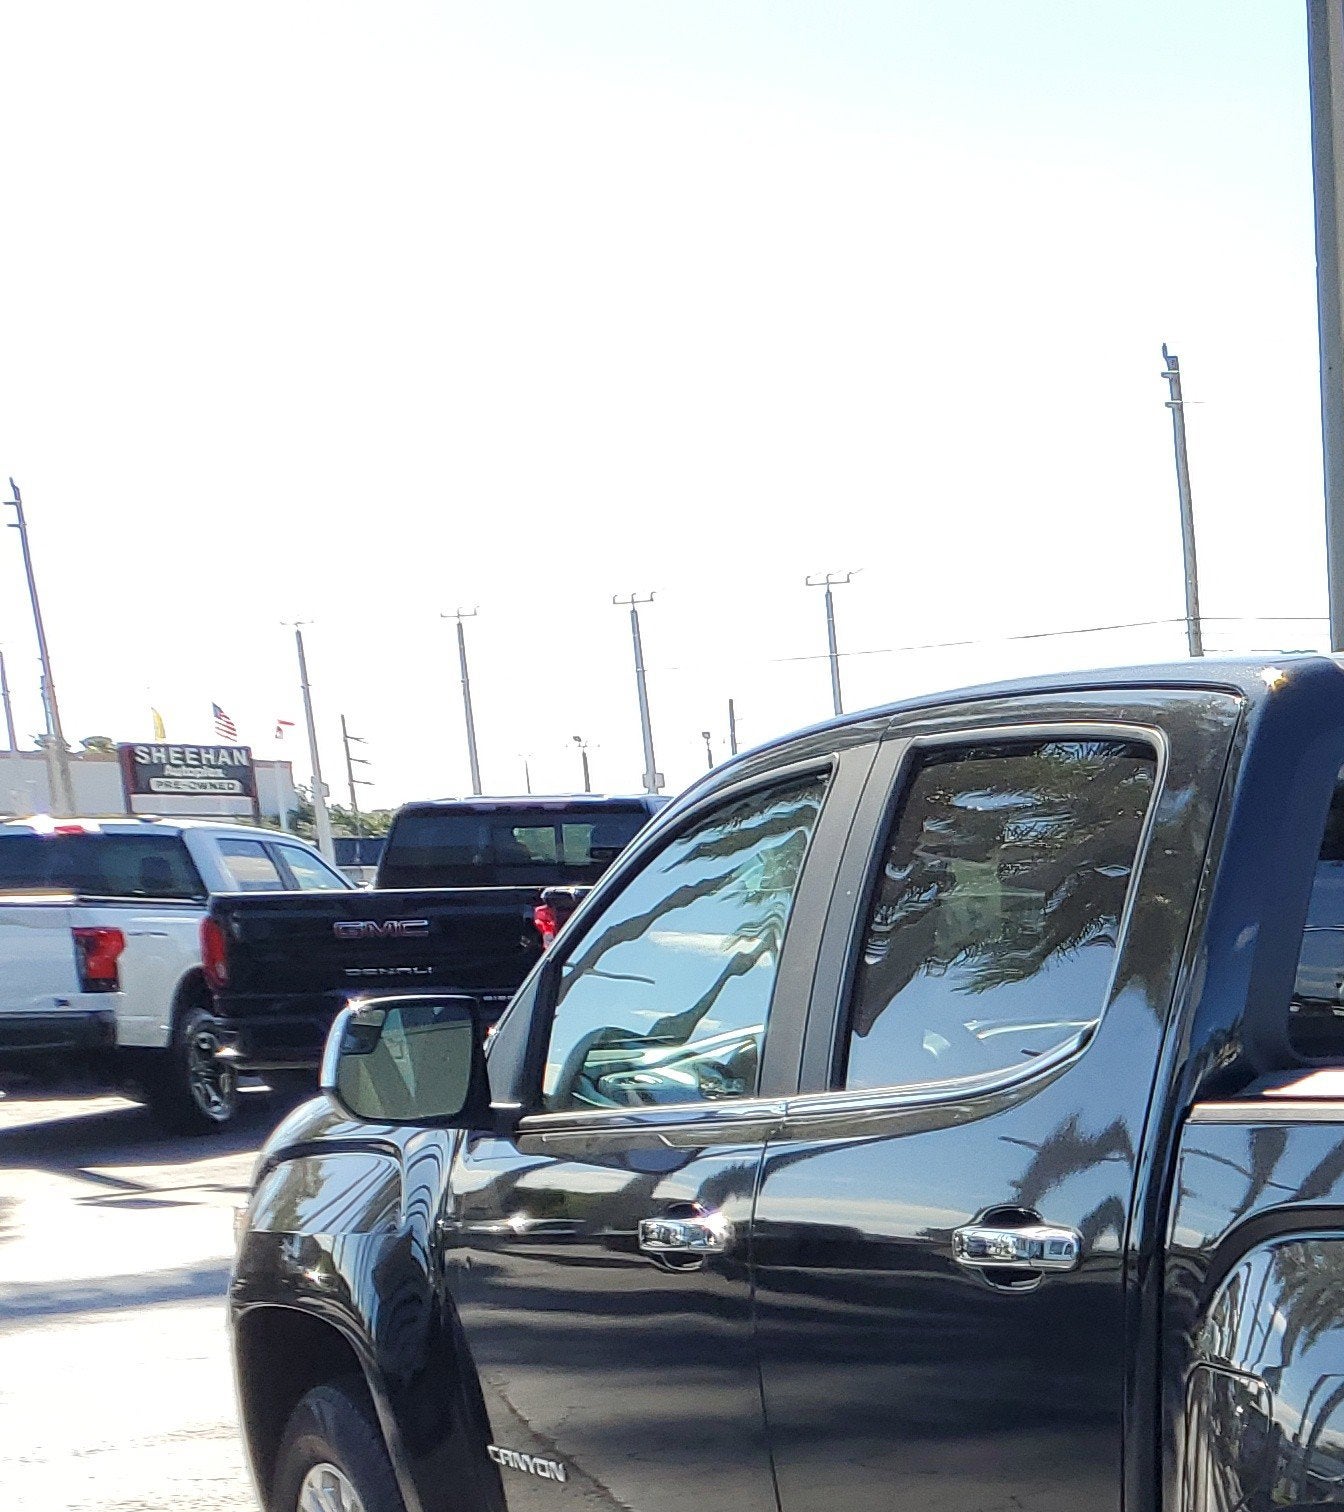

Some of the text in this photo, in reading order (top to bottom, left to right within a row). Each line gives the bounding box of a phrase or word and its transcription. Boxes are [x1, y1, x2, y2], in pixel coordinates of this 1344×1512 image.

[133, 745, 251, 767] SHEEHAN
[155, 780, 236, 791] PRE-OWNED
[333, 919, 430, 939] GMC
[486, 1445, 567, 1483] CANYON
